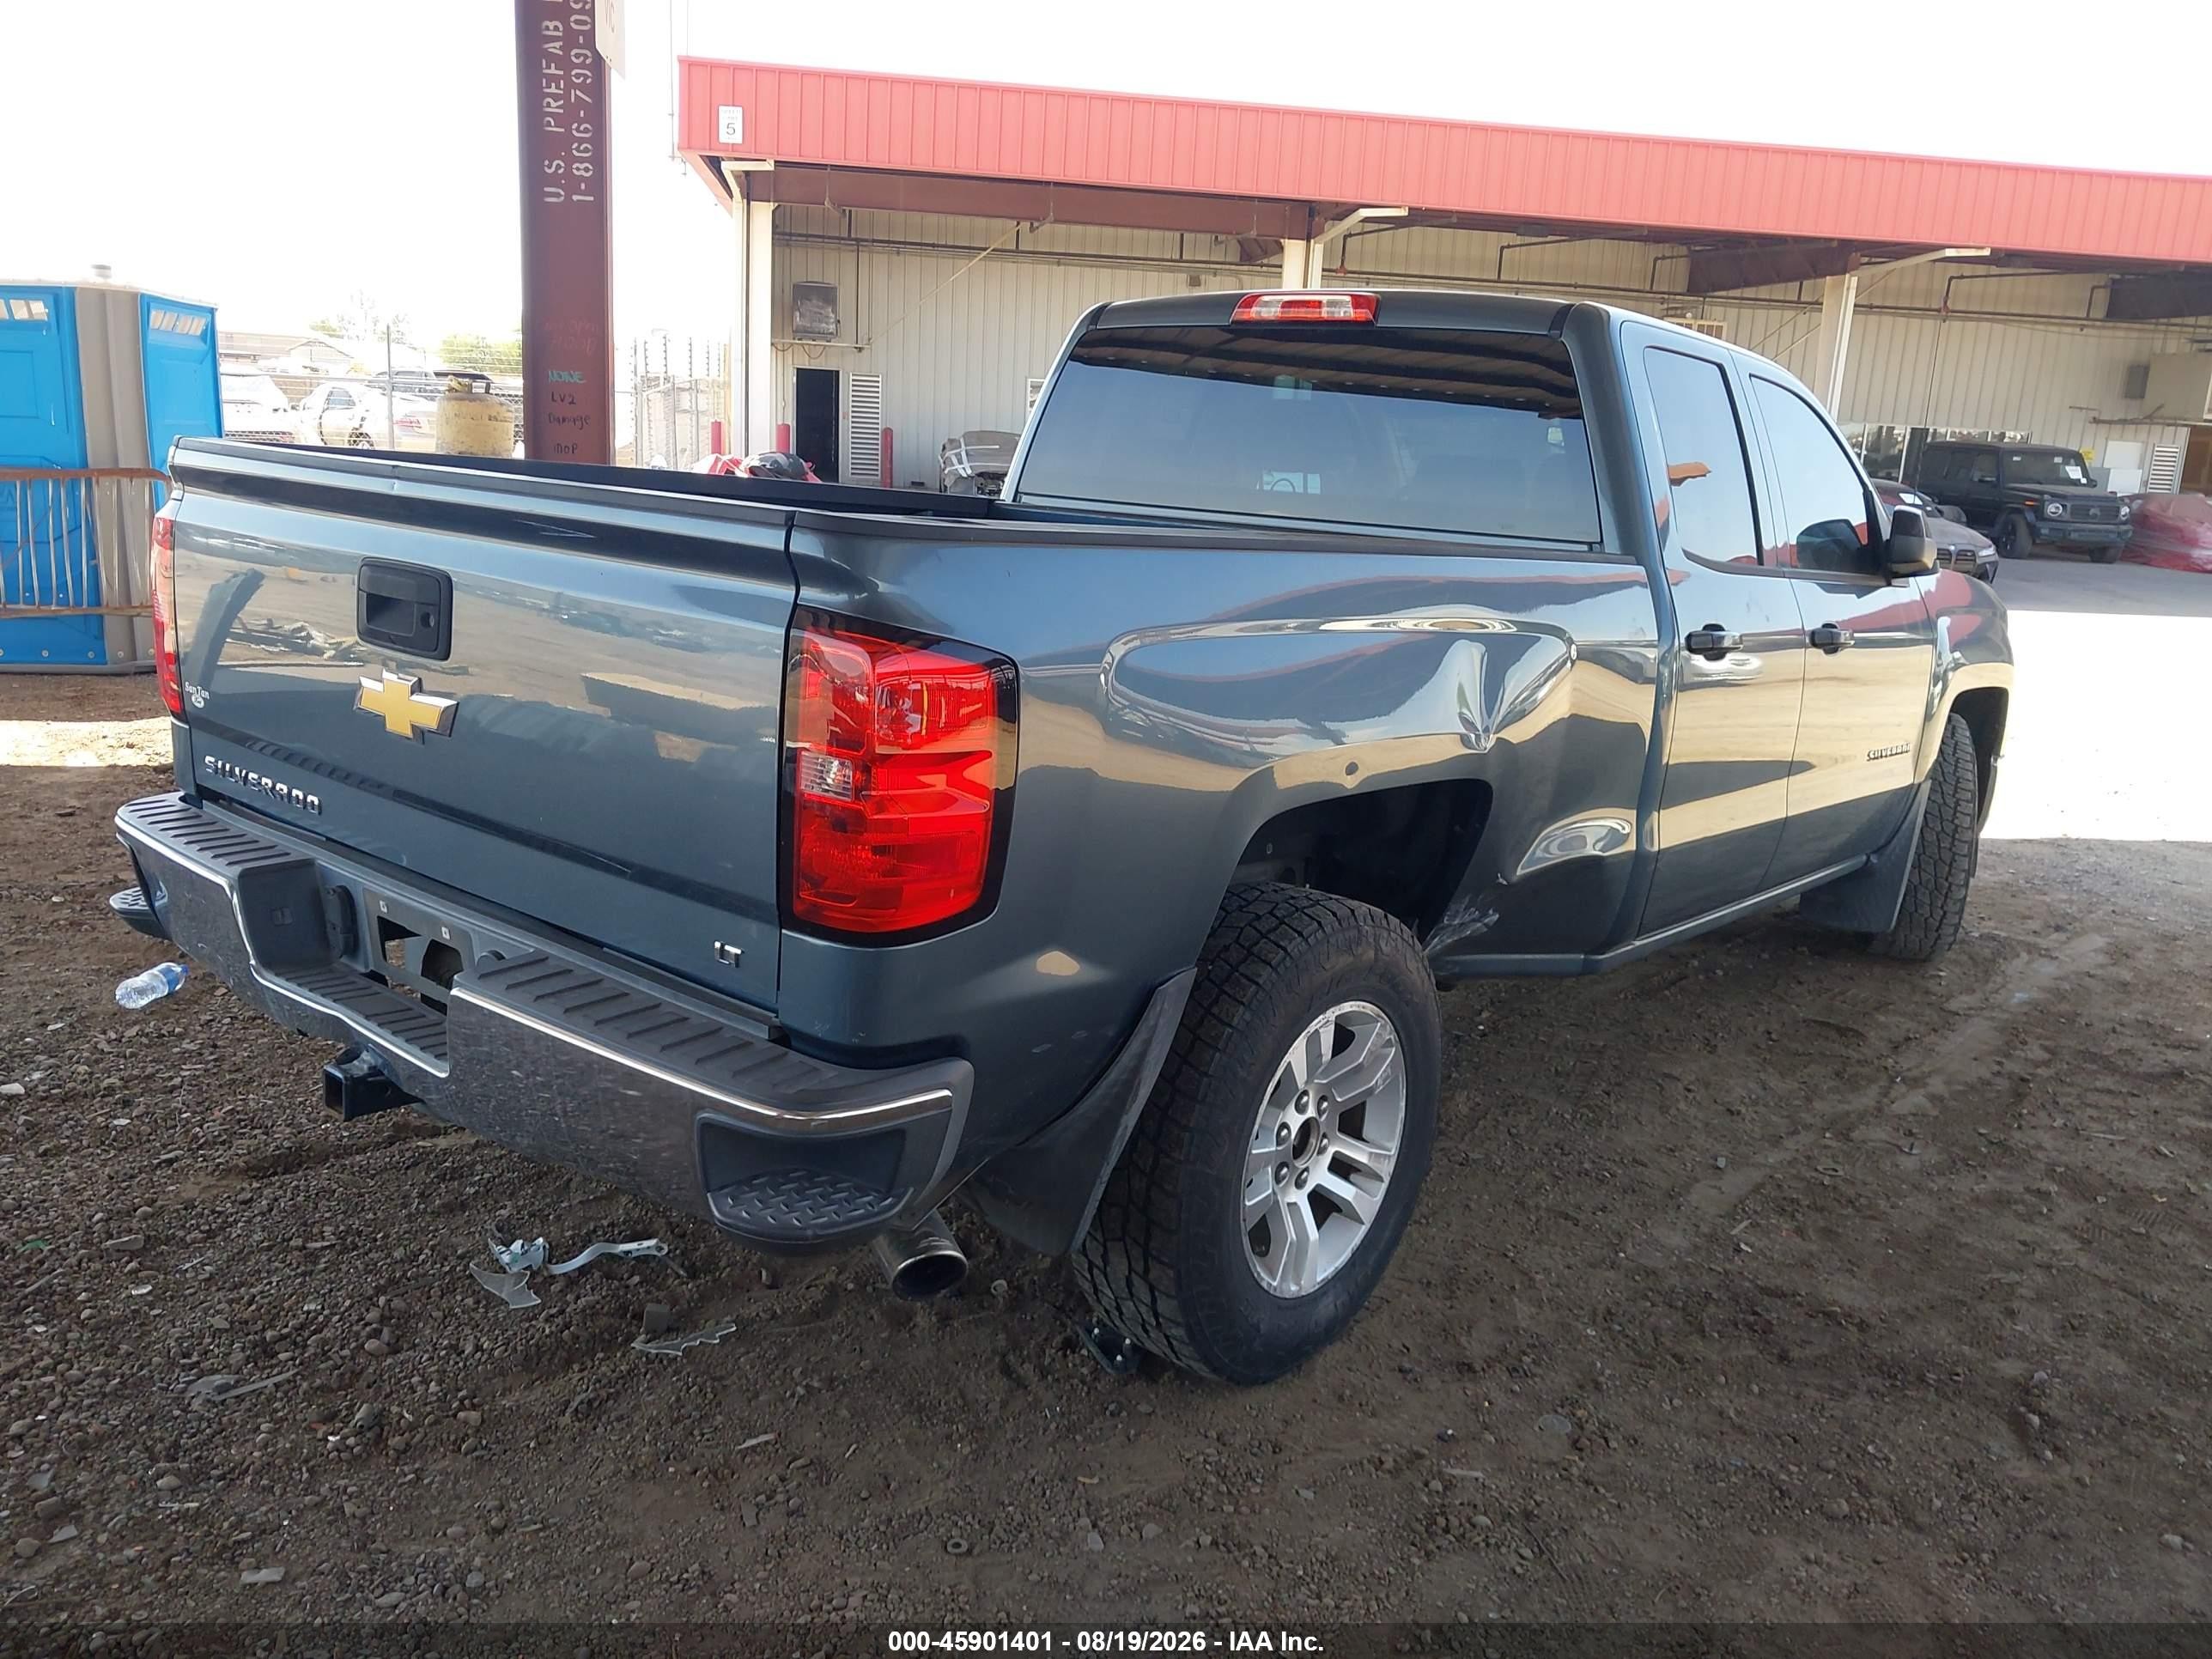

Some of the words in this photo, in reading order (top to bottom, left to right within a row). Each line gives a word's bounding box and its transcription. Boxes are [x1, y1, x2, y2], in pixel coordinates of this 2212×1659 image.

[542, 21, 565, 132] PREFAB
[726, 122, 736, 136] 5
[543, 151, 566, 203] U.S.
[204, 755, 323, 816] SILVERADO
[714, 940, 743, 968] LT
